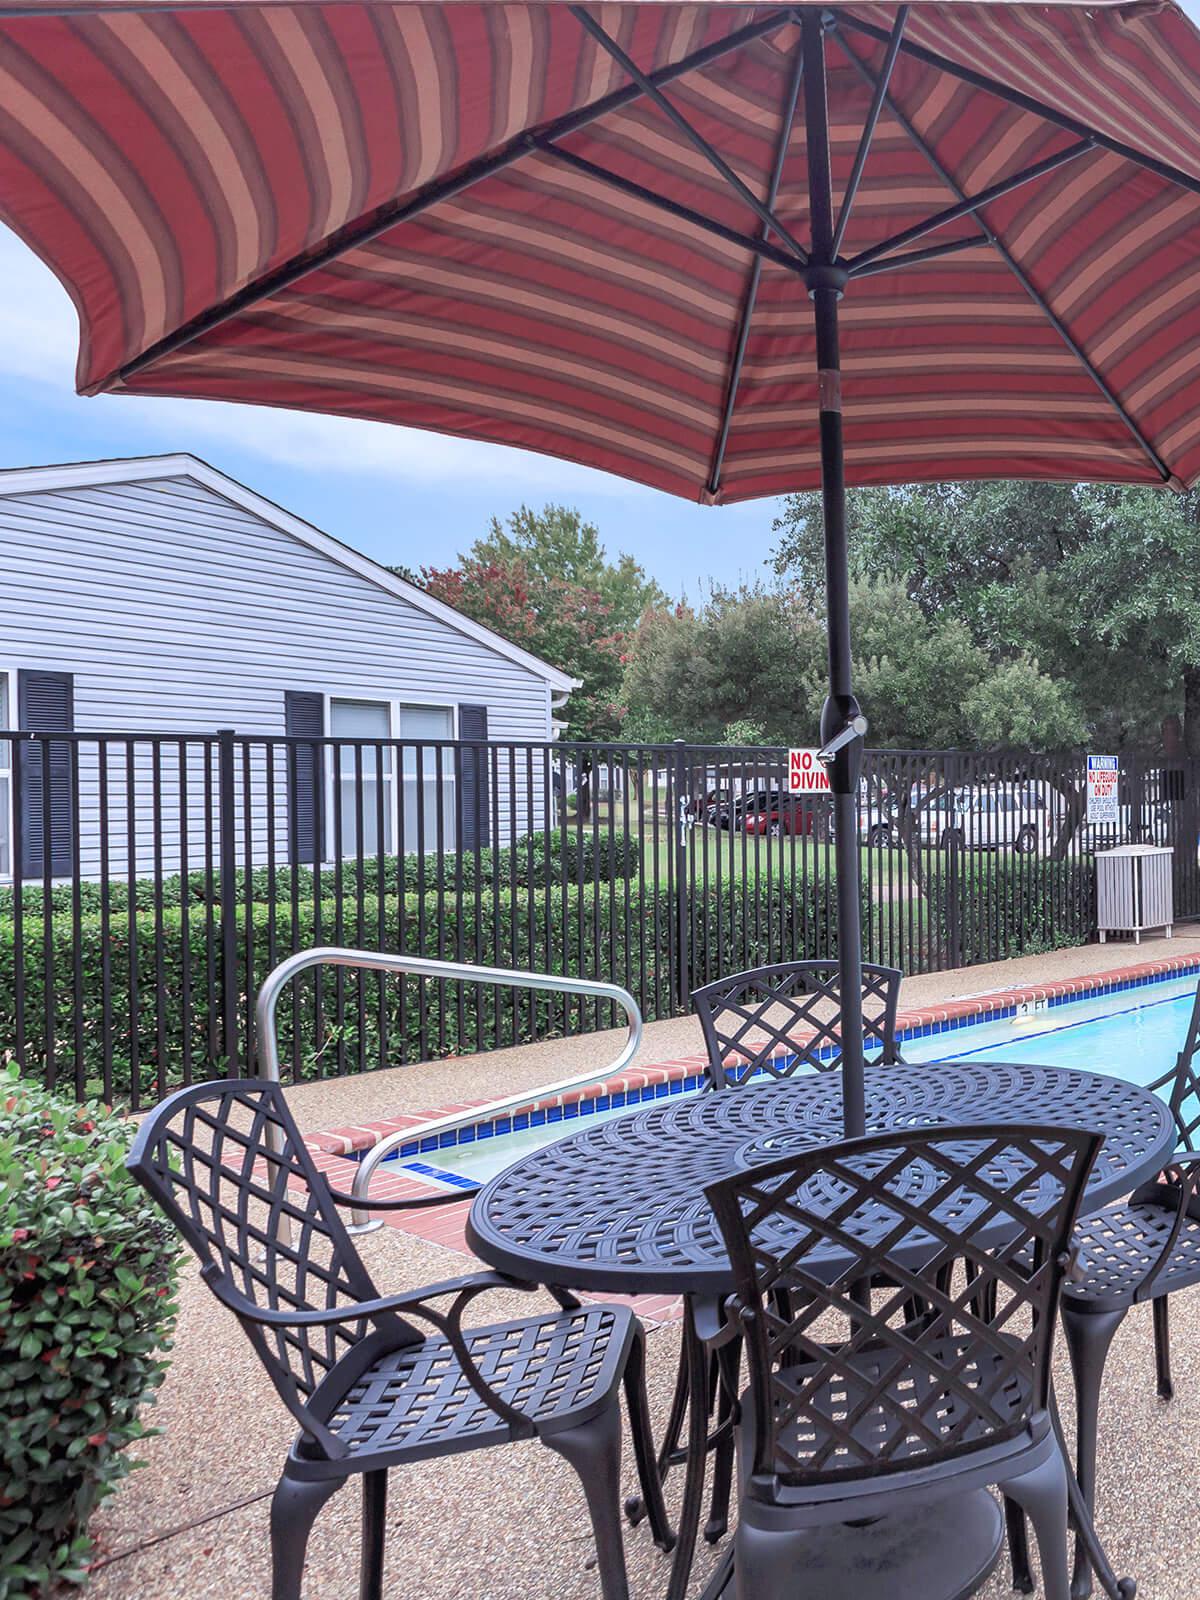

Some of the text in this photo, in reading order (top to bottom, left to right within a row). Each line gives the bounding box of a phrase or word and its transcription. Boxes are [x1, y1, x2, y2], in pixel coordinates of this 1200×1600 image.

[791, 752, 812, 770] NO
[1091, 757, 1116, 770] WARNING
[791, 771, 832, 789] DIVIN
